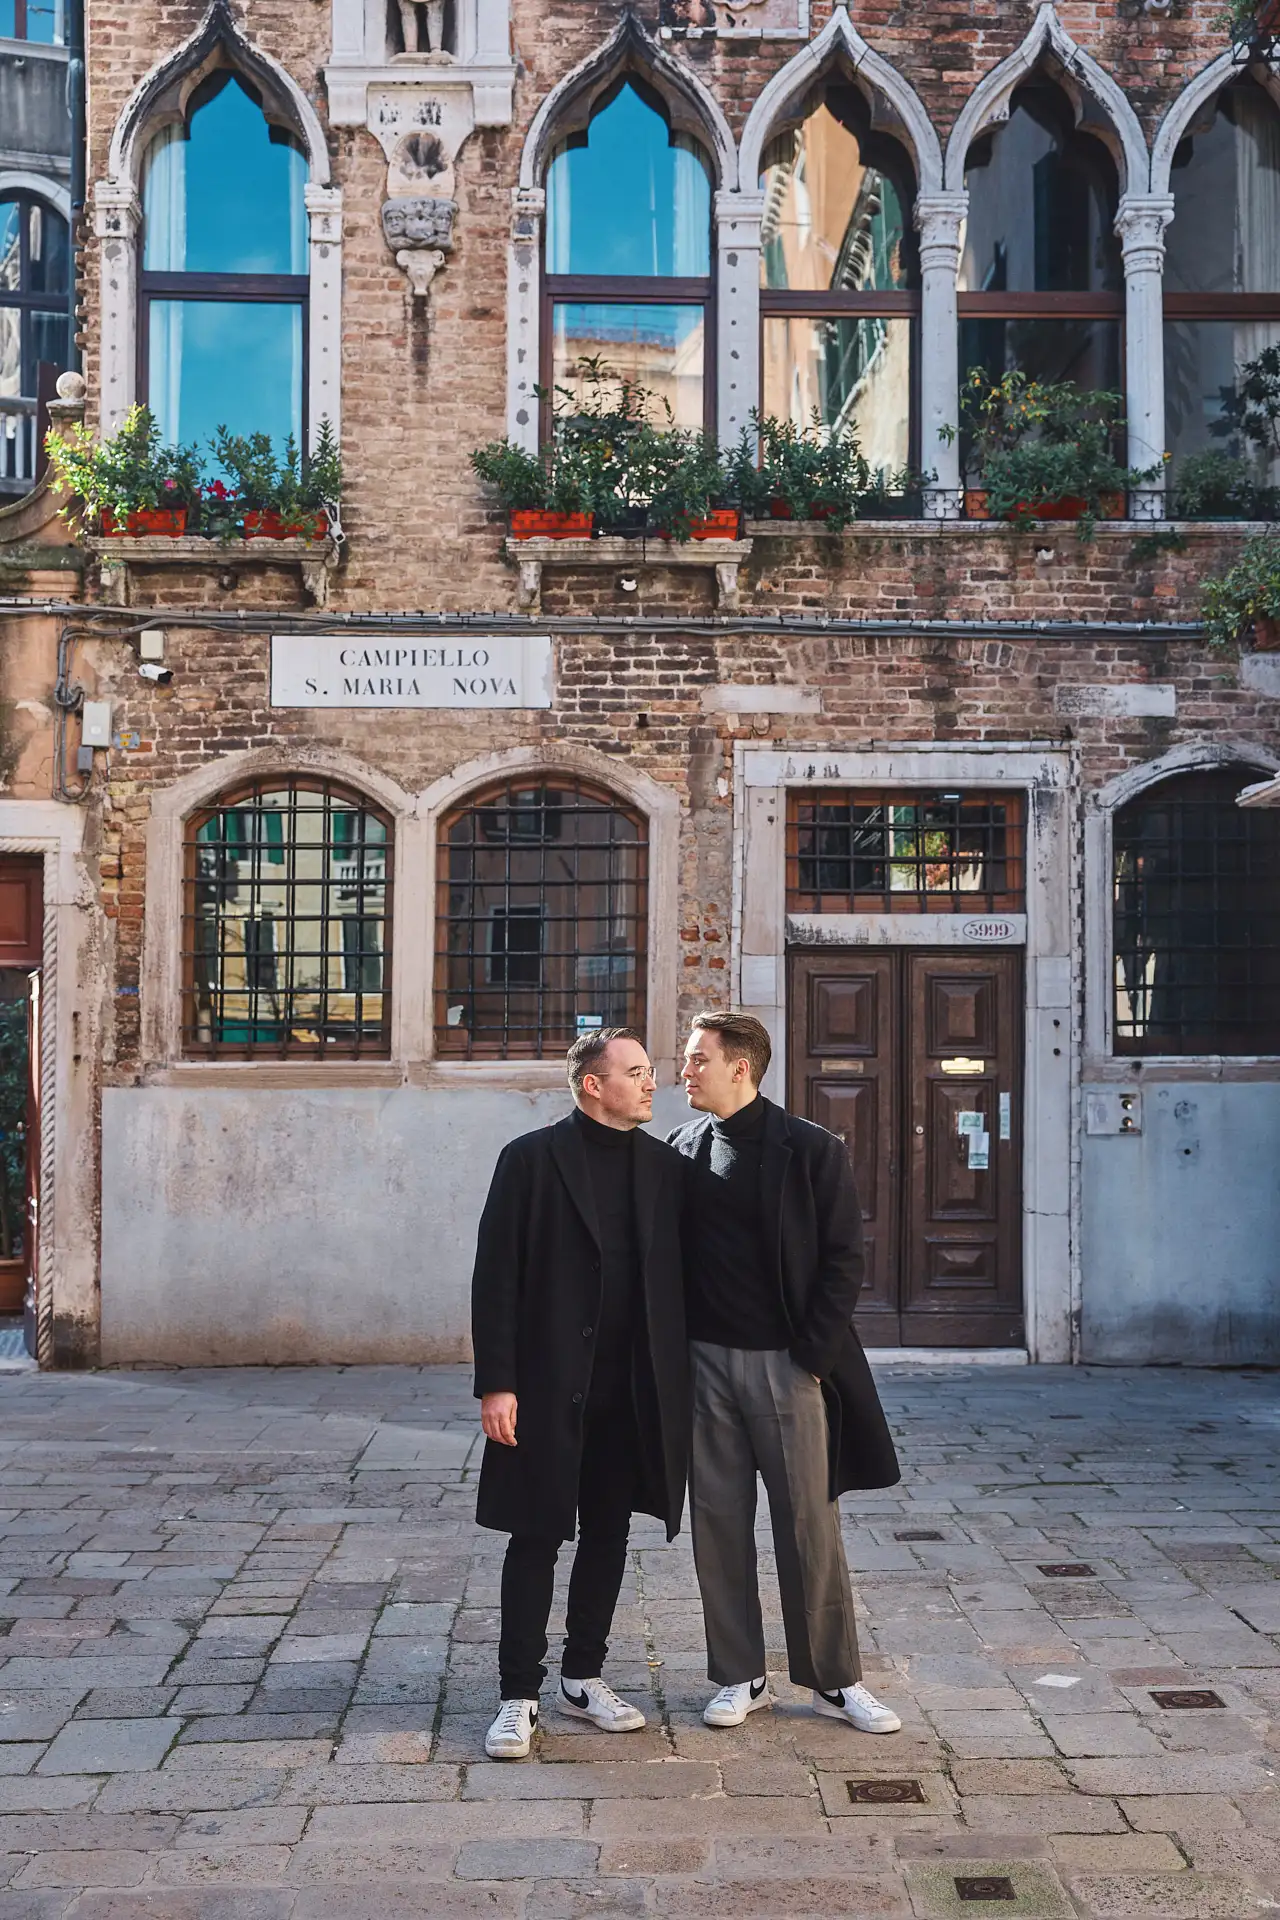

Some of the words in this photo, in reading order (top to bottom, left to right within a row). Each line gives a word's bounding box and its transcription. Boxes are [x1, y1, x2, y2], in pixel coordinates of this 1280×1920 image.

[339, 649, 490, 667] CAMPIELLO
[304, 678, 328, 695] S.
[343, 678, 421, 695] MARIA
[453, 678, 518, 695] NOVA
[968, 923, 1009, 937] 5999
